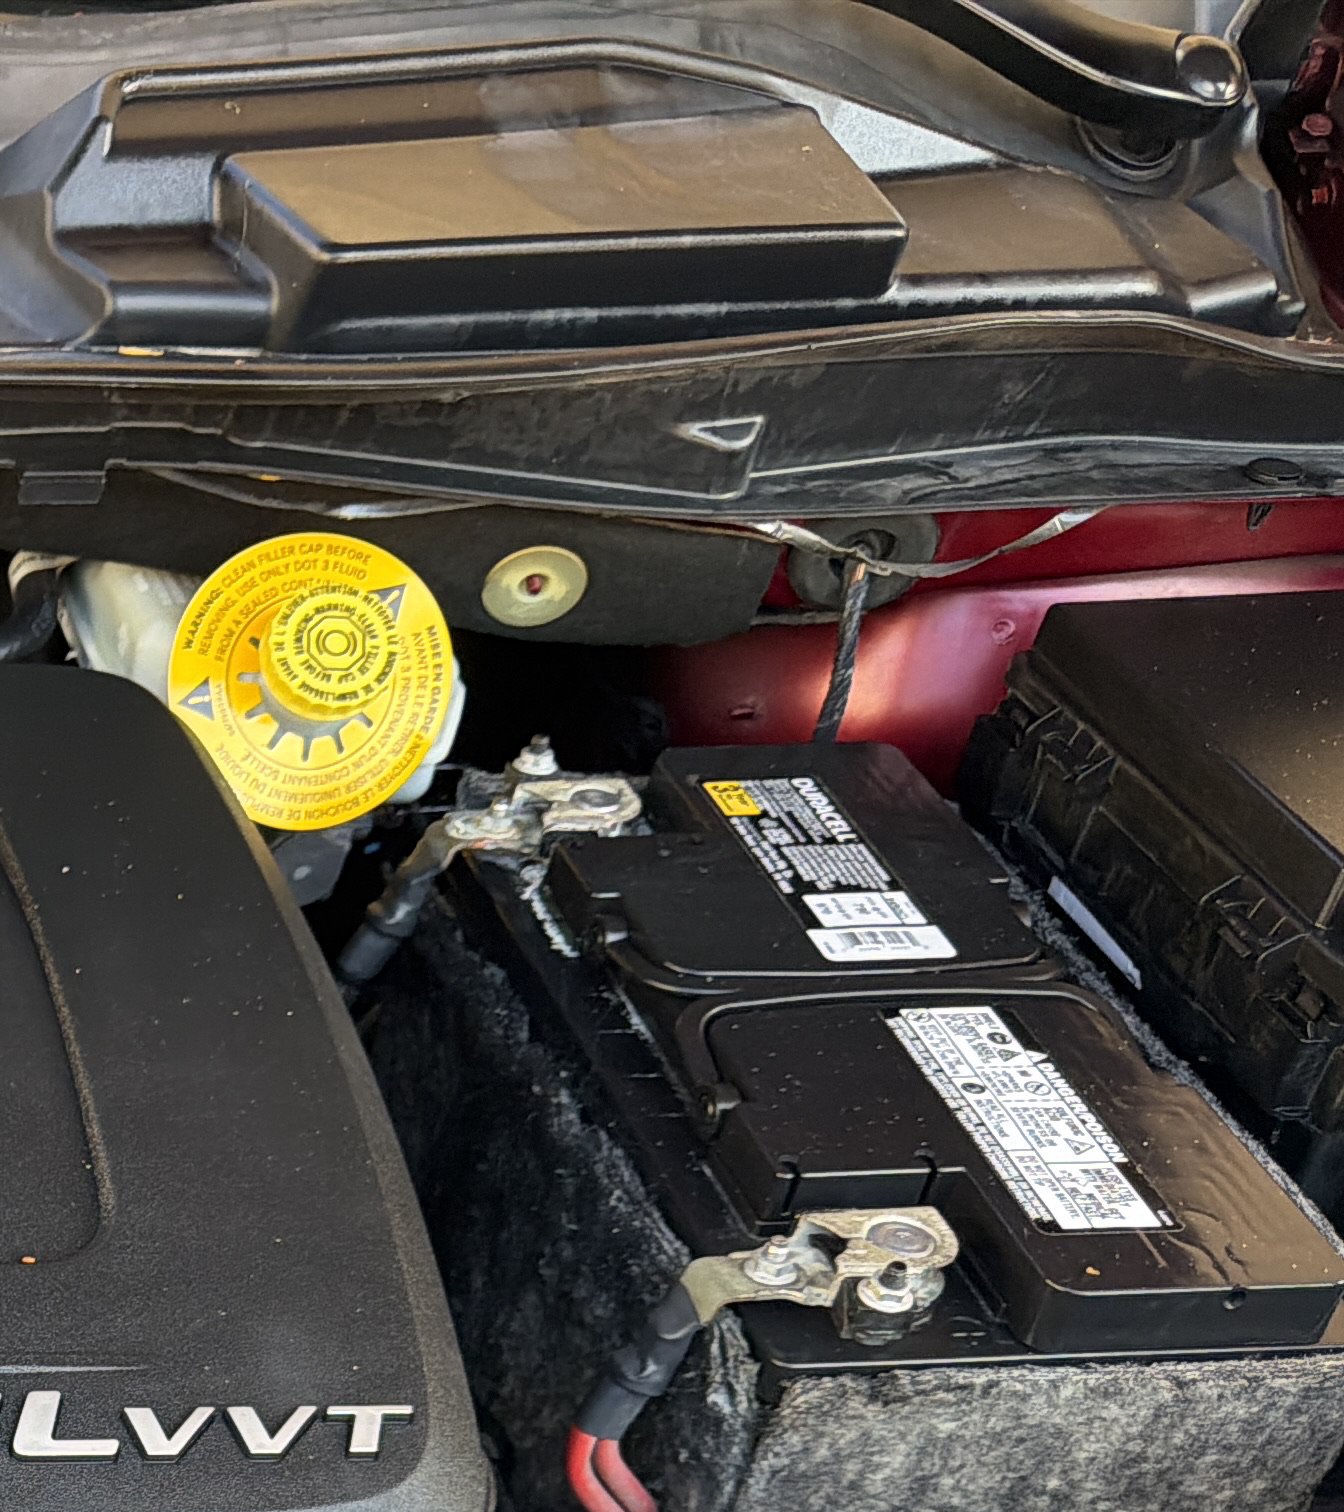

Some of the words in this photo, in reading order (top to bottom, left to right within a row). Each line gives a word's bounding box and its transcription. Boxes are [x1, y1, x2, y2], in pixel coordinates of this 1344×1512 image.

[222, 560, 256, 588] CLEAN
[256, 546, 295, 565] FILLER
[298, 543, 323, 554] CAP
[326, 544, 371, 566] BEFORE
[235, 577, 258, 597] USE
[260, 565, 289, 584] ONLY
[294, 559, 317, 571] DOT
[321, 559, 329, 571] 3
[331, 561, 367, 580] FLUID
[215, 627, 235, 662] FROM
[238, 586, 279, 619] SEALED
[430, 658, 443, 679] EN
[250, 780, 268, 796] DU
[790, 776, 859, 843] DURACELL
[286, 809, 301, 821] DE
[1039, 1060, 1129, 1164] DANGER/POISON
[123, 1403, 416, 1460] VVT
